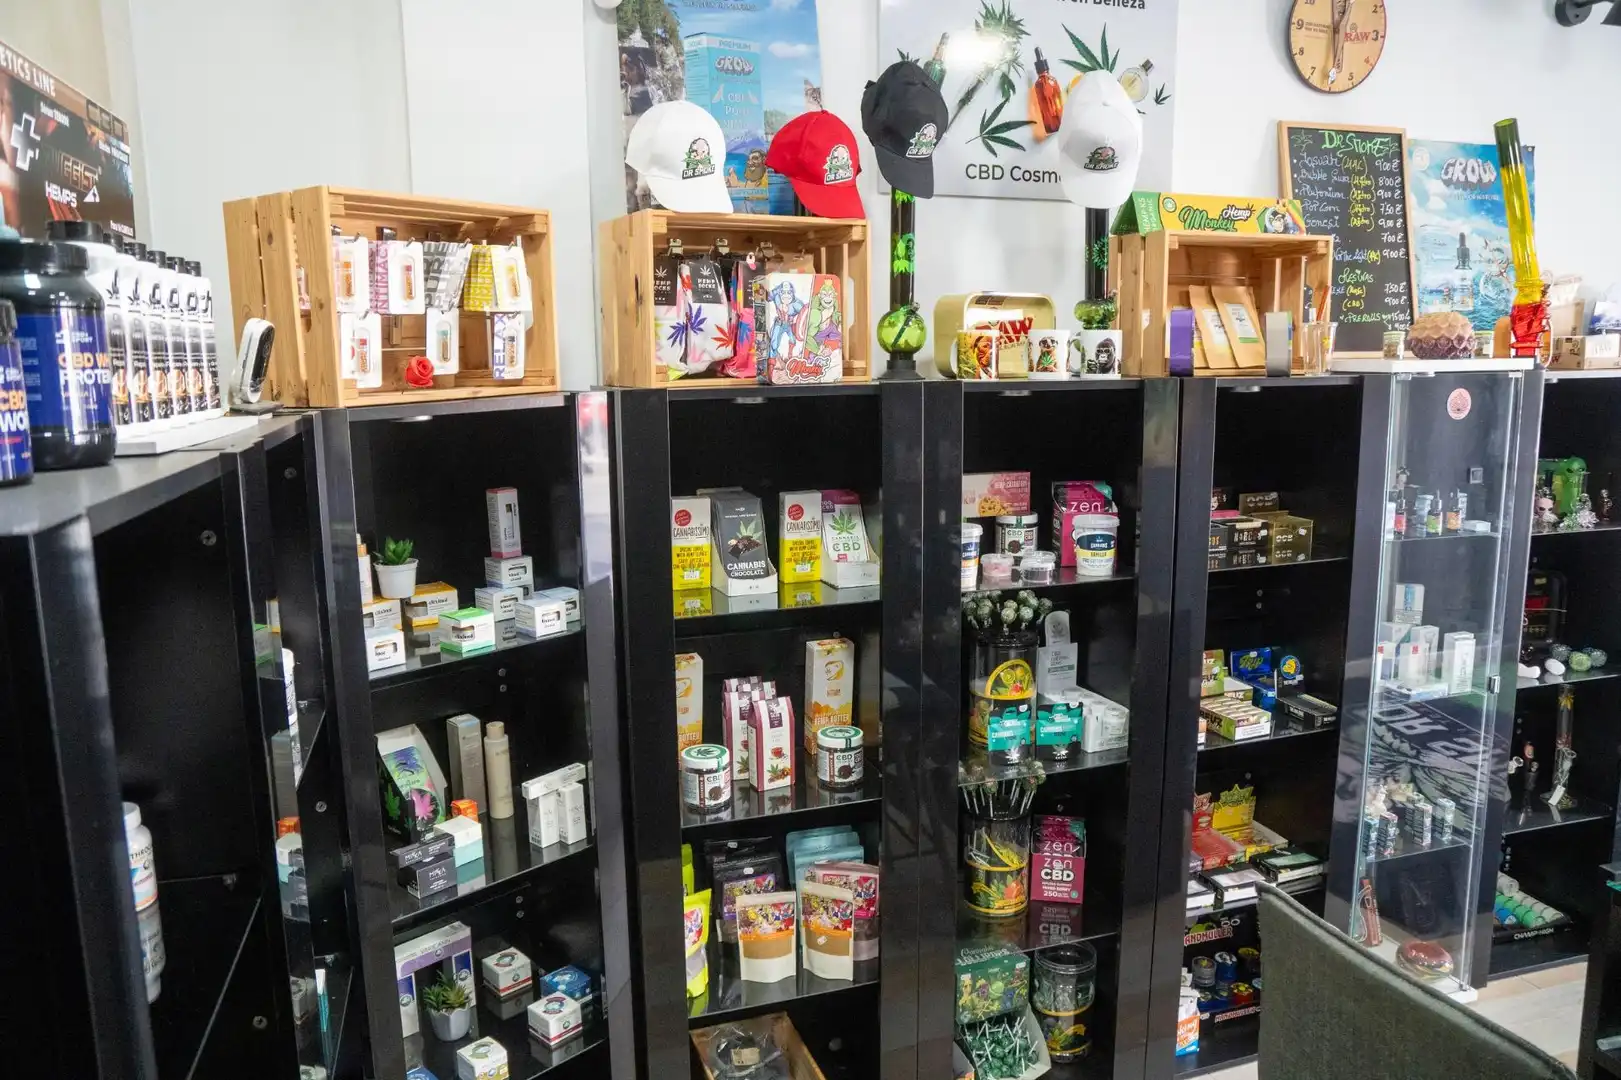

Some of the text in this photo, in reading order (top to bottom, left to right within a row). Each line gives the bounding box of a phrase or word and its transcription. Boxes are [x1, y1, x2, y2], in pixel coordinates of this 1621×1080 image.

[1296, 19, 1304, 29] 9
[1371, 30, 1379, 41] 3
[1299, 47, 1304, 55] 8
[714, 55, 755, 74] GROW
[1310, 66, 1316, 75] 7
[1348, 72, 1354, 81] 5
[34, 69, 56, 97] LINE
[683, 169, 694, 178] DR
[965, 163, 1004, 181] CBD
[1441, 157, 1497, 184] GROW
[1178, 205, 1252, 231] Monkey Hemp
[493, 314, 506, 380] RELAX
[58, 352, 94, 370] CBD
[1070, 501, 1102, 512] zen
[832, 541, 861, 552] CBD
[727, 560, 766, 571] CANNABIS
[730, 569, 764, 577] CHOCOLATE
[1040, 868, 1075, 881] CBD
